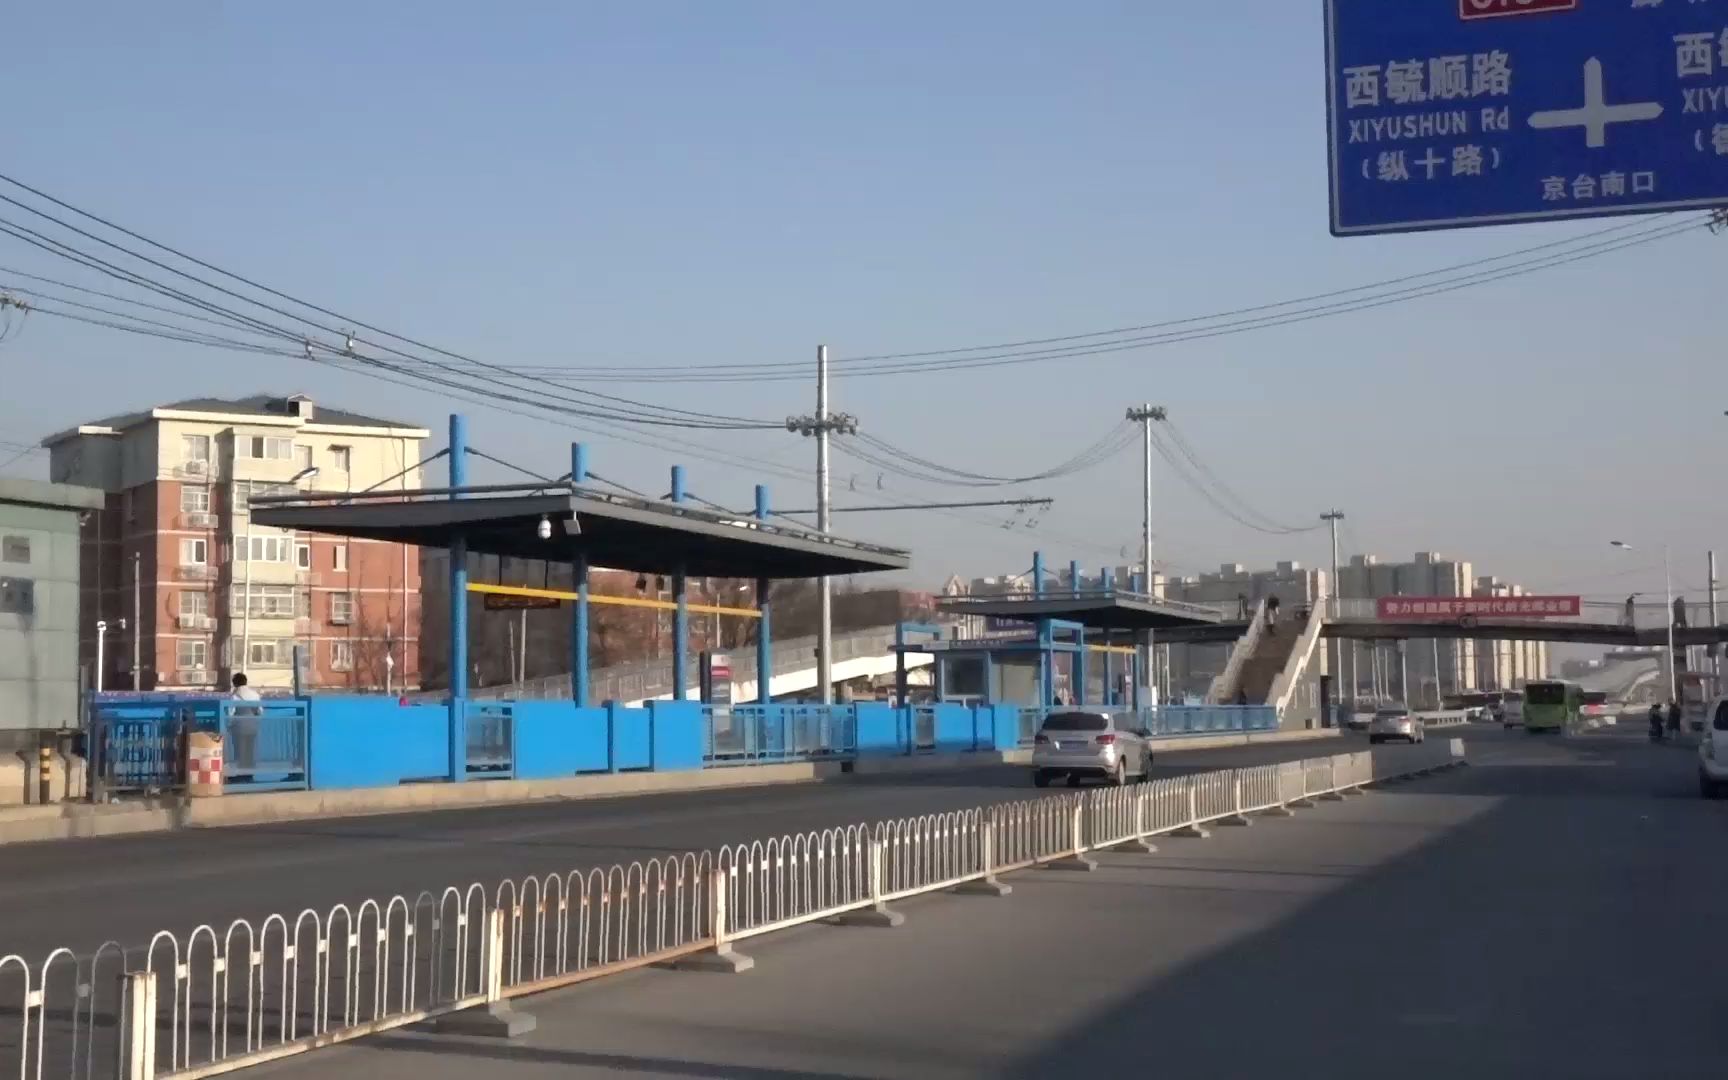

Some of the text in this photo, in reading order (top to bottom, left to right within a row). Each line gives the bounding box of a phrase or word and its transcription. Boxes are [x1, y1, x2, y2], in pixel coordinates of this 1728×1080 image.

[1343, 50, 1512, 109] 西毓顺路
[1682, 86, 1728, 114] XIY
[1348, 105, 1509, 144] XIYUSHUN Rd
[1541, 170, 1655, 201] 京台南口
